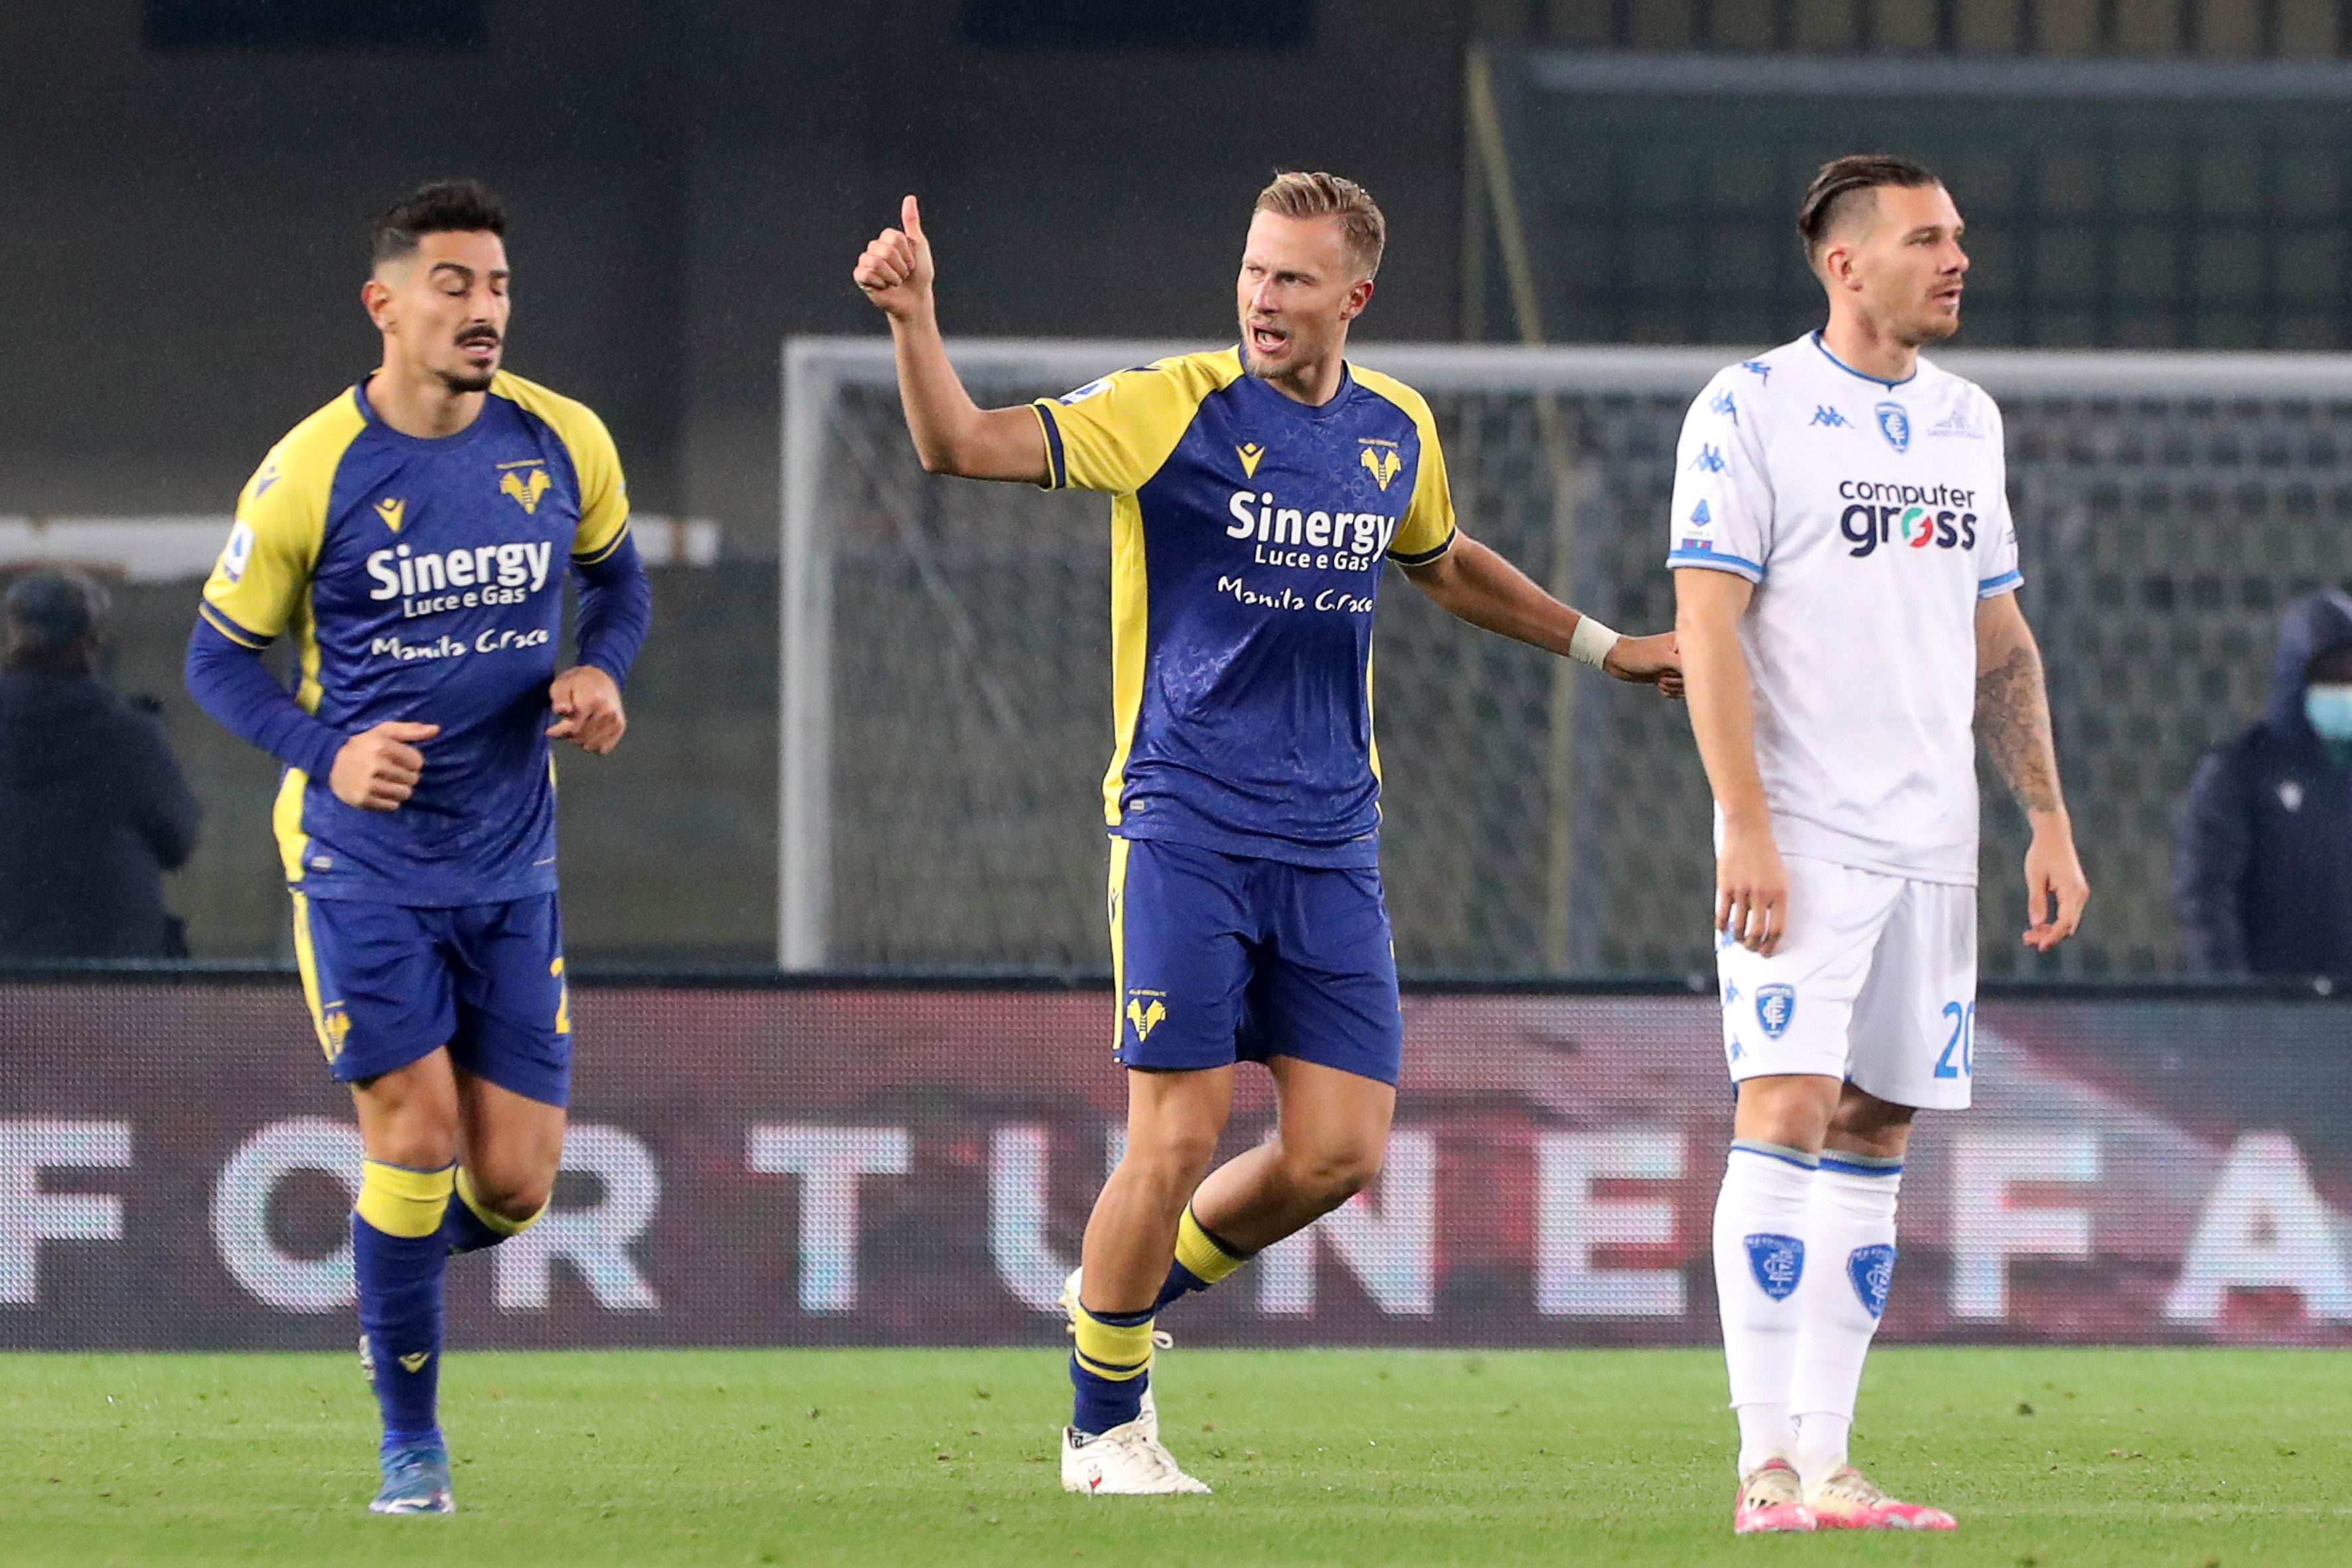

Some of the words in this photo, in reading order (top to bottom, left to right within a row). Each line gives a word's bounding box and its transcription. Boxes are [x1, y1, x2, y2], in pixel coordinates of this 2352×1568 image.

[1840, 481, 1975, 508] computer
[1226, 491, 1395, 563] Sinergy
[1841, 504, 1977, 558] gross
[366, 540, 552, 600] Sinergy
[1255, 544, 1311, 569] Luce
[1316, 554, 1328, 570] e
[1334, 550, 1370, 572] Gas
[403, 595, 461, 618] Luce
[463, 591, 479, 608] e
[481, 585, 526, 605] Gas
[1217, 575, 1305, 611] Manila
[1315, 588, 1373, 612] Grace
[371, 634, 467, 661] Manila
[475, 629, 549, 653] Grace
